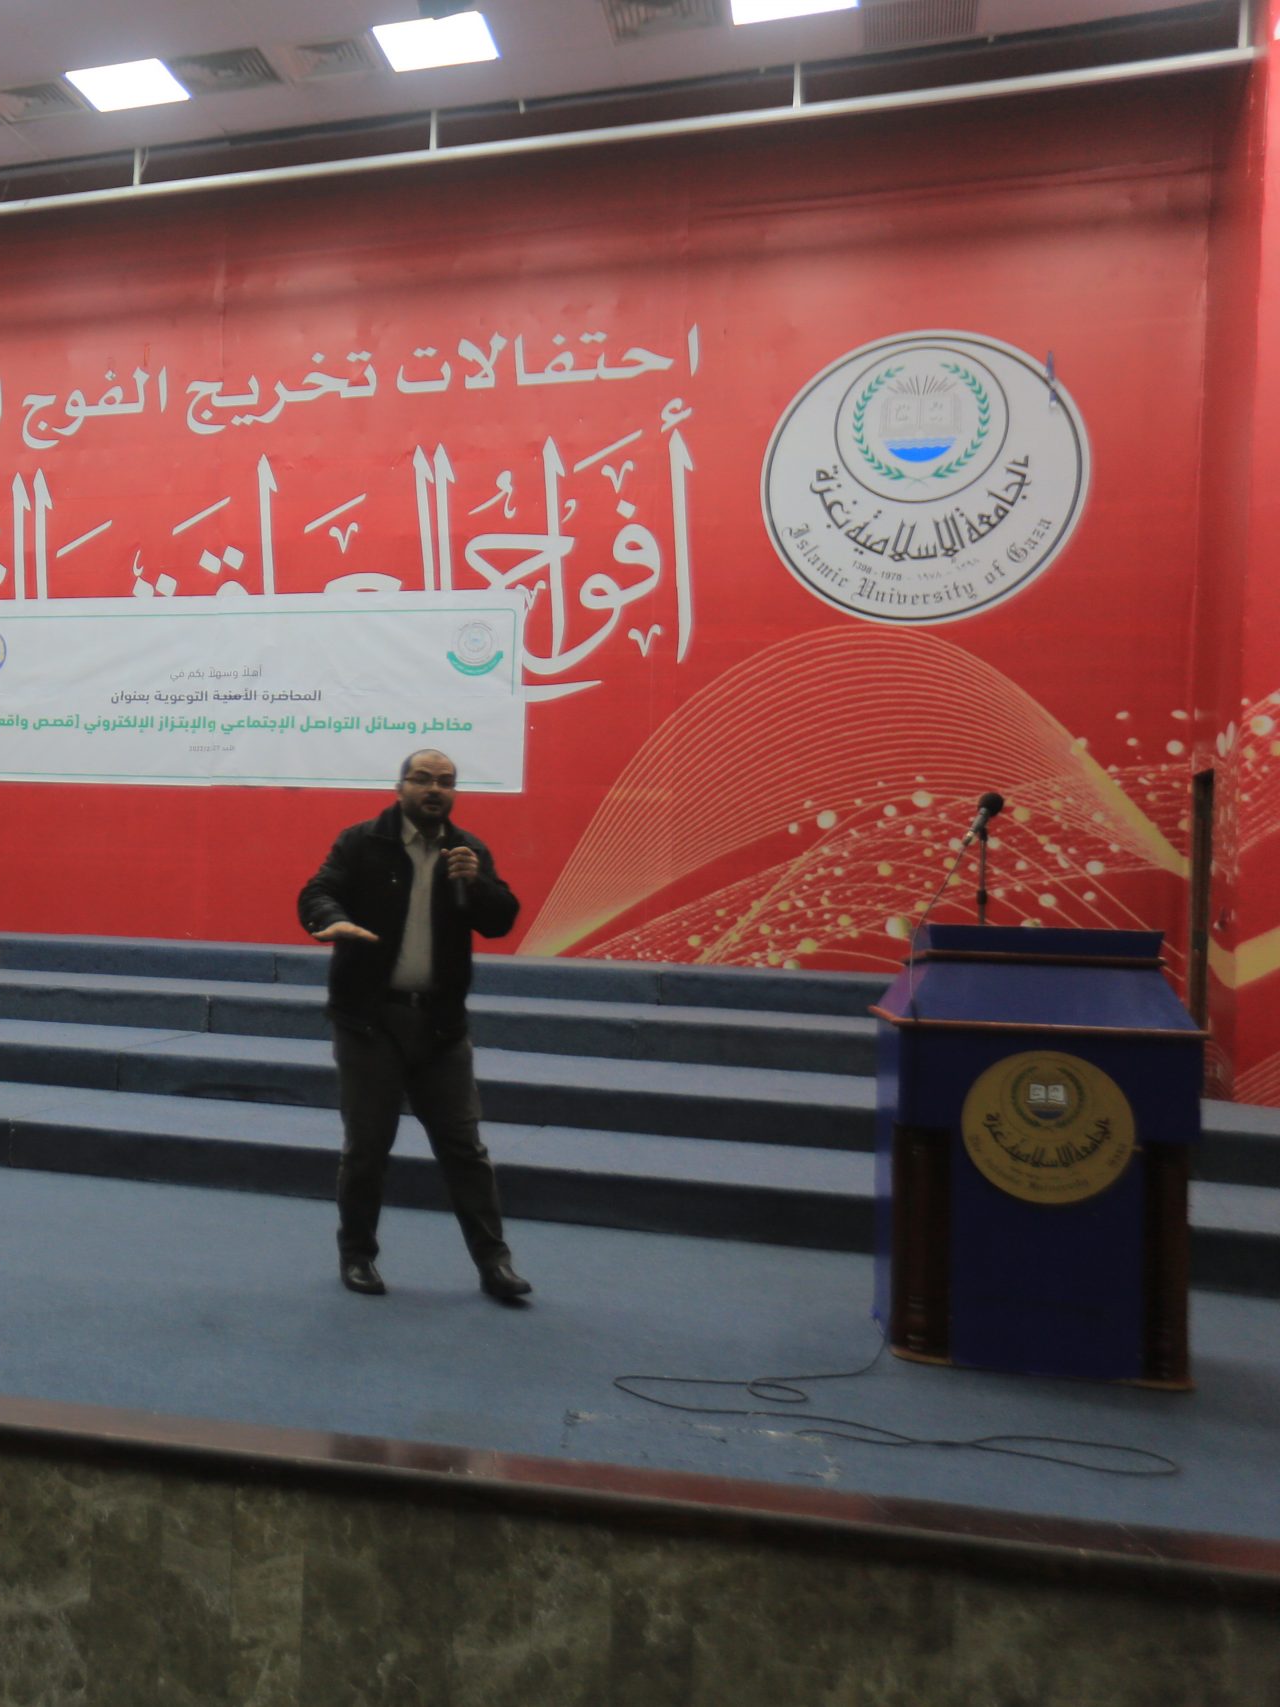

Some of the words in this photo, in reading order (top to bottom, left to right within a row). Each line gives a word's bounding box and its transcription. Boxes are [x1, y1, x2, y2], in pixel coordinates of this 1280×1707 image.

[397, 323, 699, 393] احتفالات
[185, 350, 377, 434] تخريج
[22, 365, 167, 449] الفوج
[782, 523, 850, 589] Islamic
[851, 576, 978, 607] University
[983, 559, 1007, 585] of
[1006, 516, 1053, 565] Gaza
[169, 668, 185, 682] في
[187, 667, 206, 681] بكم
[110, 690, 151, 704] بعنوان
[154, 690, 209, 705] التوعوية
[261, 690, 322, 705] المحاضرة
[83, 714, 155, 735] الإلكتروني
[300, 715, 361, 733] التواصل
[365, 716, 417, 734] وسائل
[420, 717, 473, 735] مخاطر
